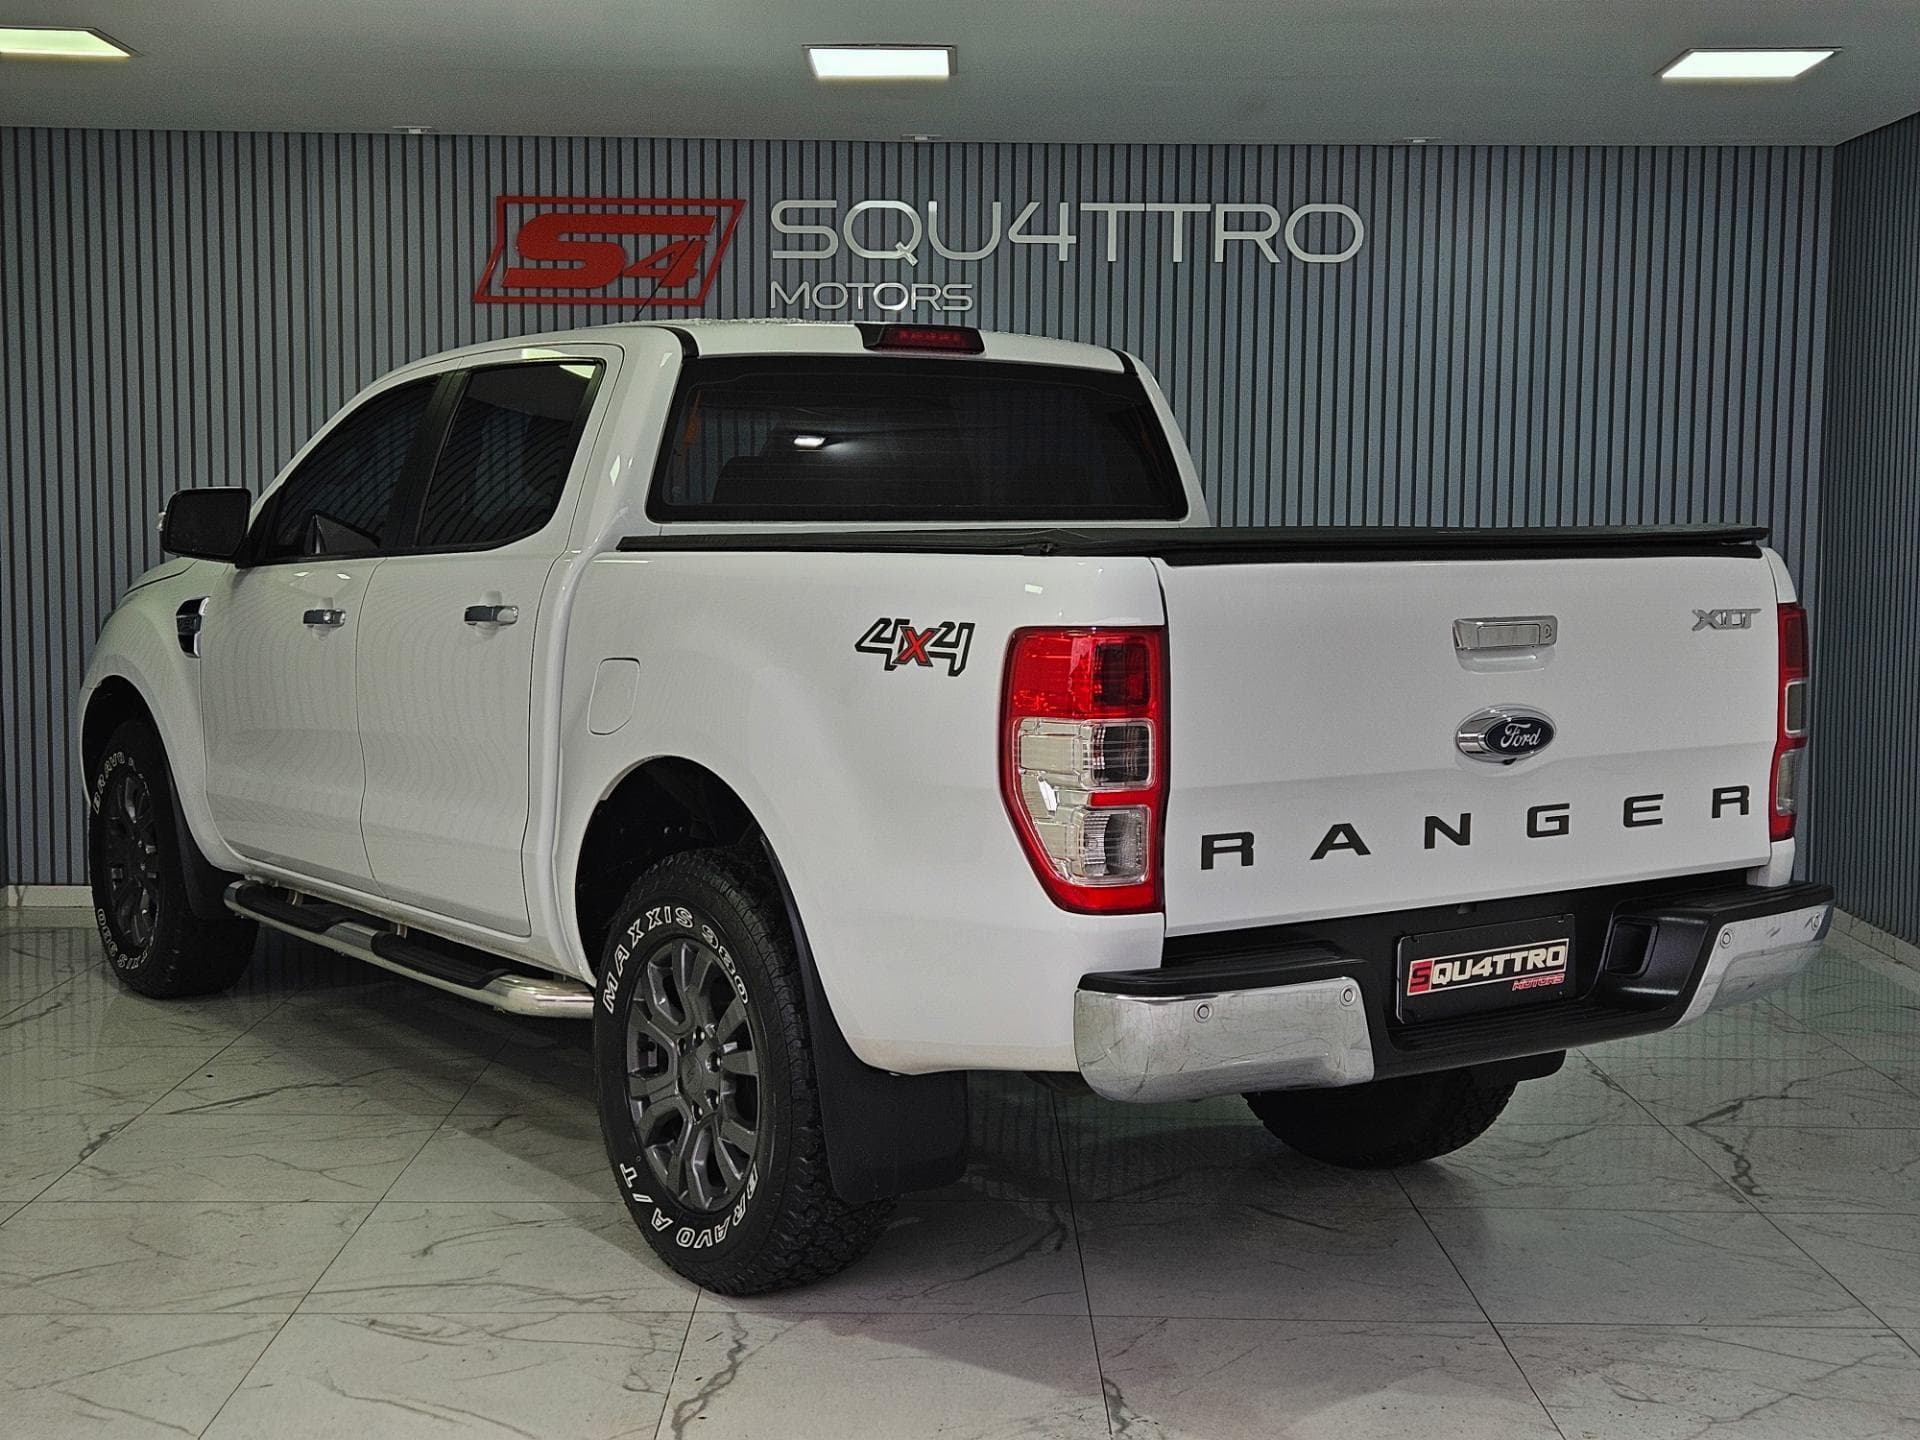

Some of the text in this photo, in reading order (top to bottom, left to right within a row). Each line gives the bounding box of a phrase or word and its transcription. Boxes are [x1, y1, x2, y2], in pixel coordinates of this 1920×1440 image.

[502, 212, 718, 289] S4
[770, 199, 1365, 267] SQU4TTRO
[770, 280, 974, 312] MOTORS
[1692, 607, 1762, 632] XLT
[1500, 722, 1541, 748] Ford
[1200, 785, 1750, 870] RANGER
[602, 905, 748, 1015] MAXXIS 980
[1409, 944, 1566, 994] SQU4TTRO
[1512, 973, 1565, 991] MOTORS
[620, 1162, 759, 1249] BRAVO A/T
